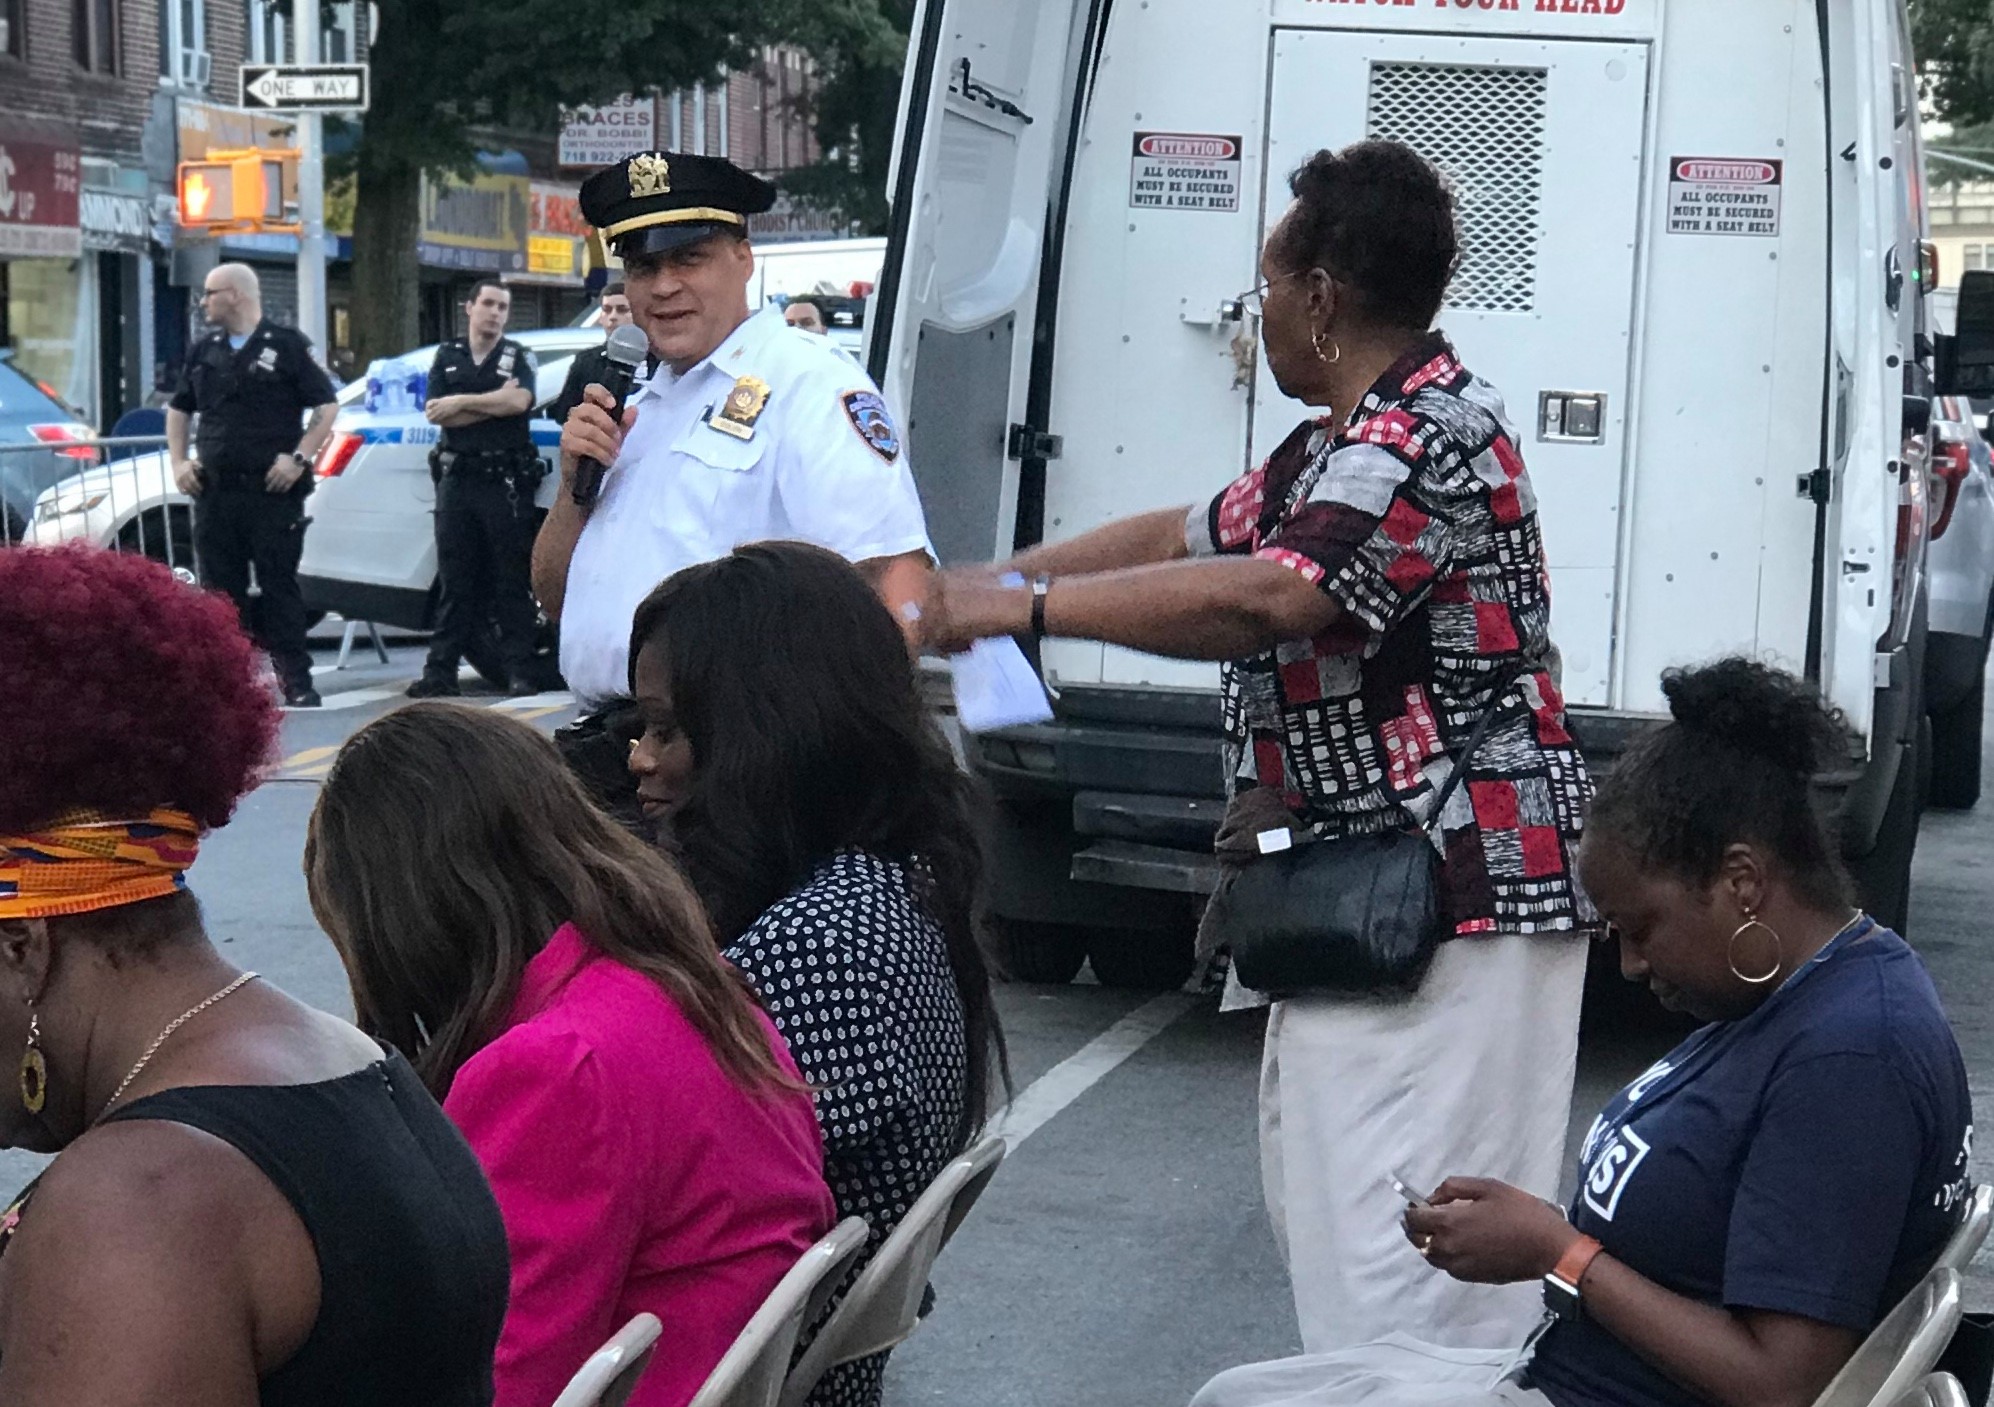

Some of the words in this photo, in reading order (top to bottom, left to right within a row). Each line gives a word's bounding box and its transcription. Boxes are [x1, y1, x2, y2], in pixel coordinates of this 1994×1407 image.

[261, 79, 295, 97] ONE
[312, 79, 350, 97] WAY
[562, 140, 650, 149] ORTHODONTIST
[1150, 139, 1225, 156] ATTENTION
[564, 150, 587, 162] 718
[1143, 166, 1163, 177] ALL
[1167, 168, 1229, 180] OCCUPANTS
[1688, 164, 1765, 180] ATTENTION
[1136, 180, 1165, 192] MUST
[1169, 181, 1182, 192] BE
[1186, 182, 1234, 194] SECURED
[1134, 193, 1162, 205] WITH
[1166, 195, 1174, 206] A
[1177, 196, 1205, 207] SEAT
[1208, 197, 1235, 208] BELT
[1680, 191, 1701, 203] ALL
[1705, 193, 1769, 205] OCCUPANTS
[1673, 205, 1703, 216] MUST
[1707, 206, 1721, 217] BE
[1725, 207, 1774, 219] SECURED
[1671, 219, 1700, 231] WITH
[1704, 220, 1712, 231] A
[1717, 221, 1745, 232] SEAT
[1748, 222, 1776, 233] BELT
[407, 427, 437, 445] 3119
